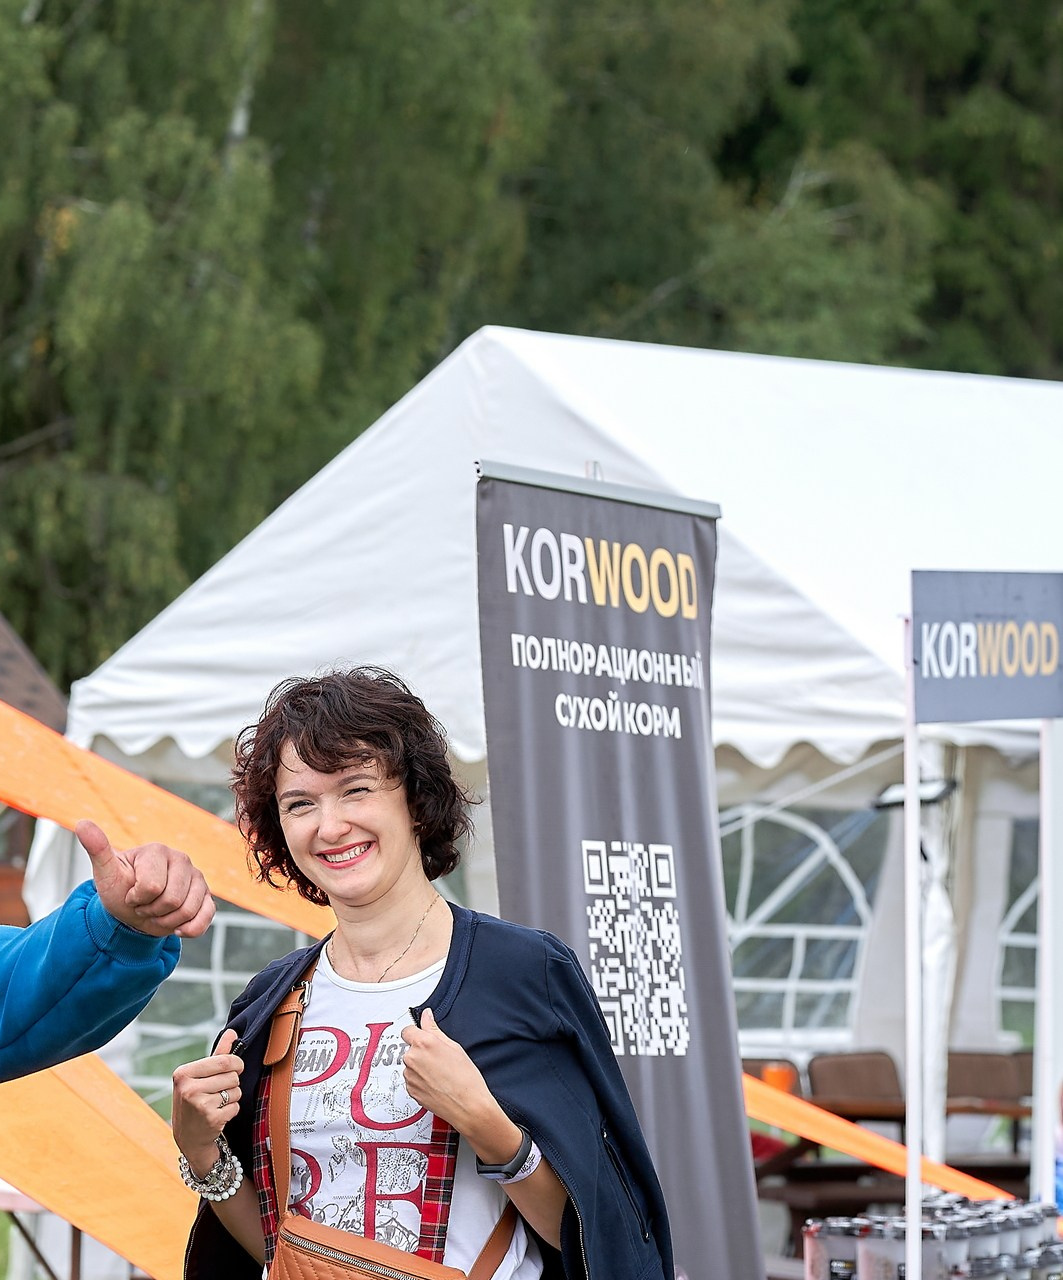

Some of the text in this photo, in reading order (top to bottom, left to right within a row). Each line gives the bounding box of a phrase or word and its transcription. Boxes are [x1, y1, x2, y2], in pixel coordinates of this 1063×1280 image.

[502, 523, 699, 620] KORWOOD
[921, 621, 1059, 679] KORWOOD
[554, 690, 682, 739] СУХОЙ КОРМ
